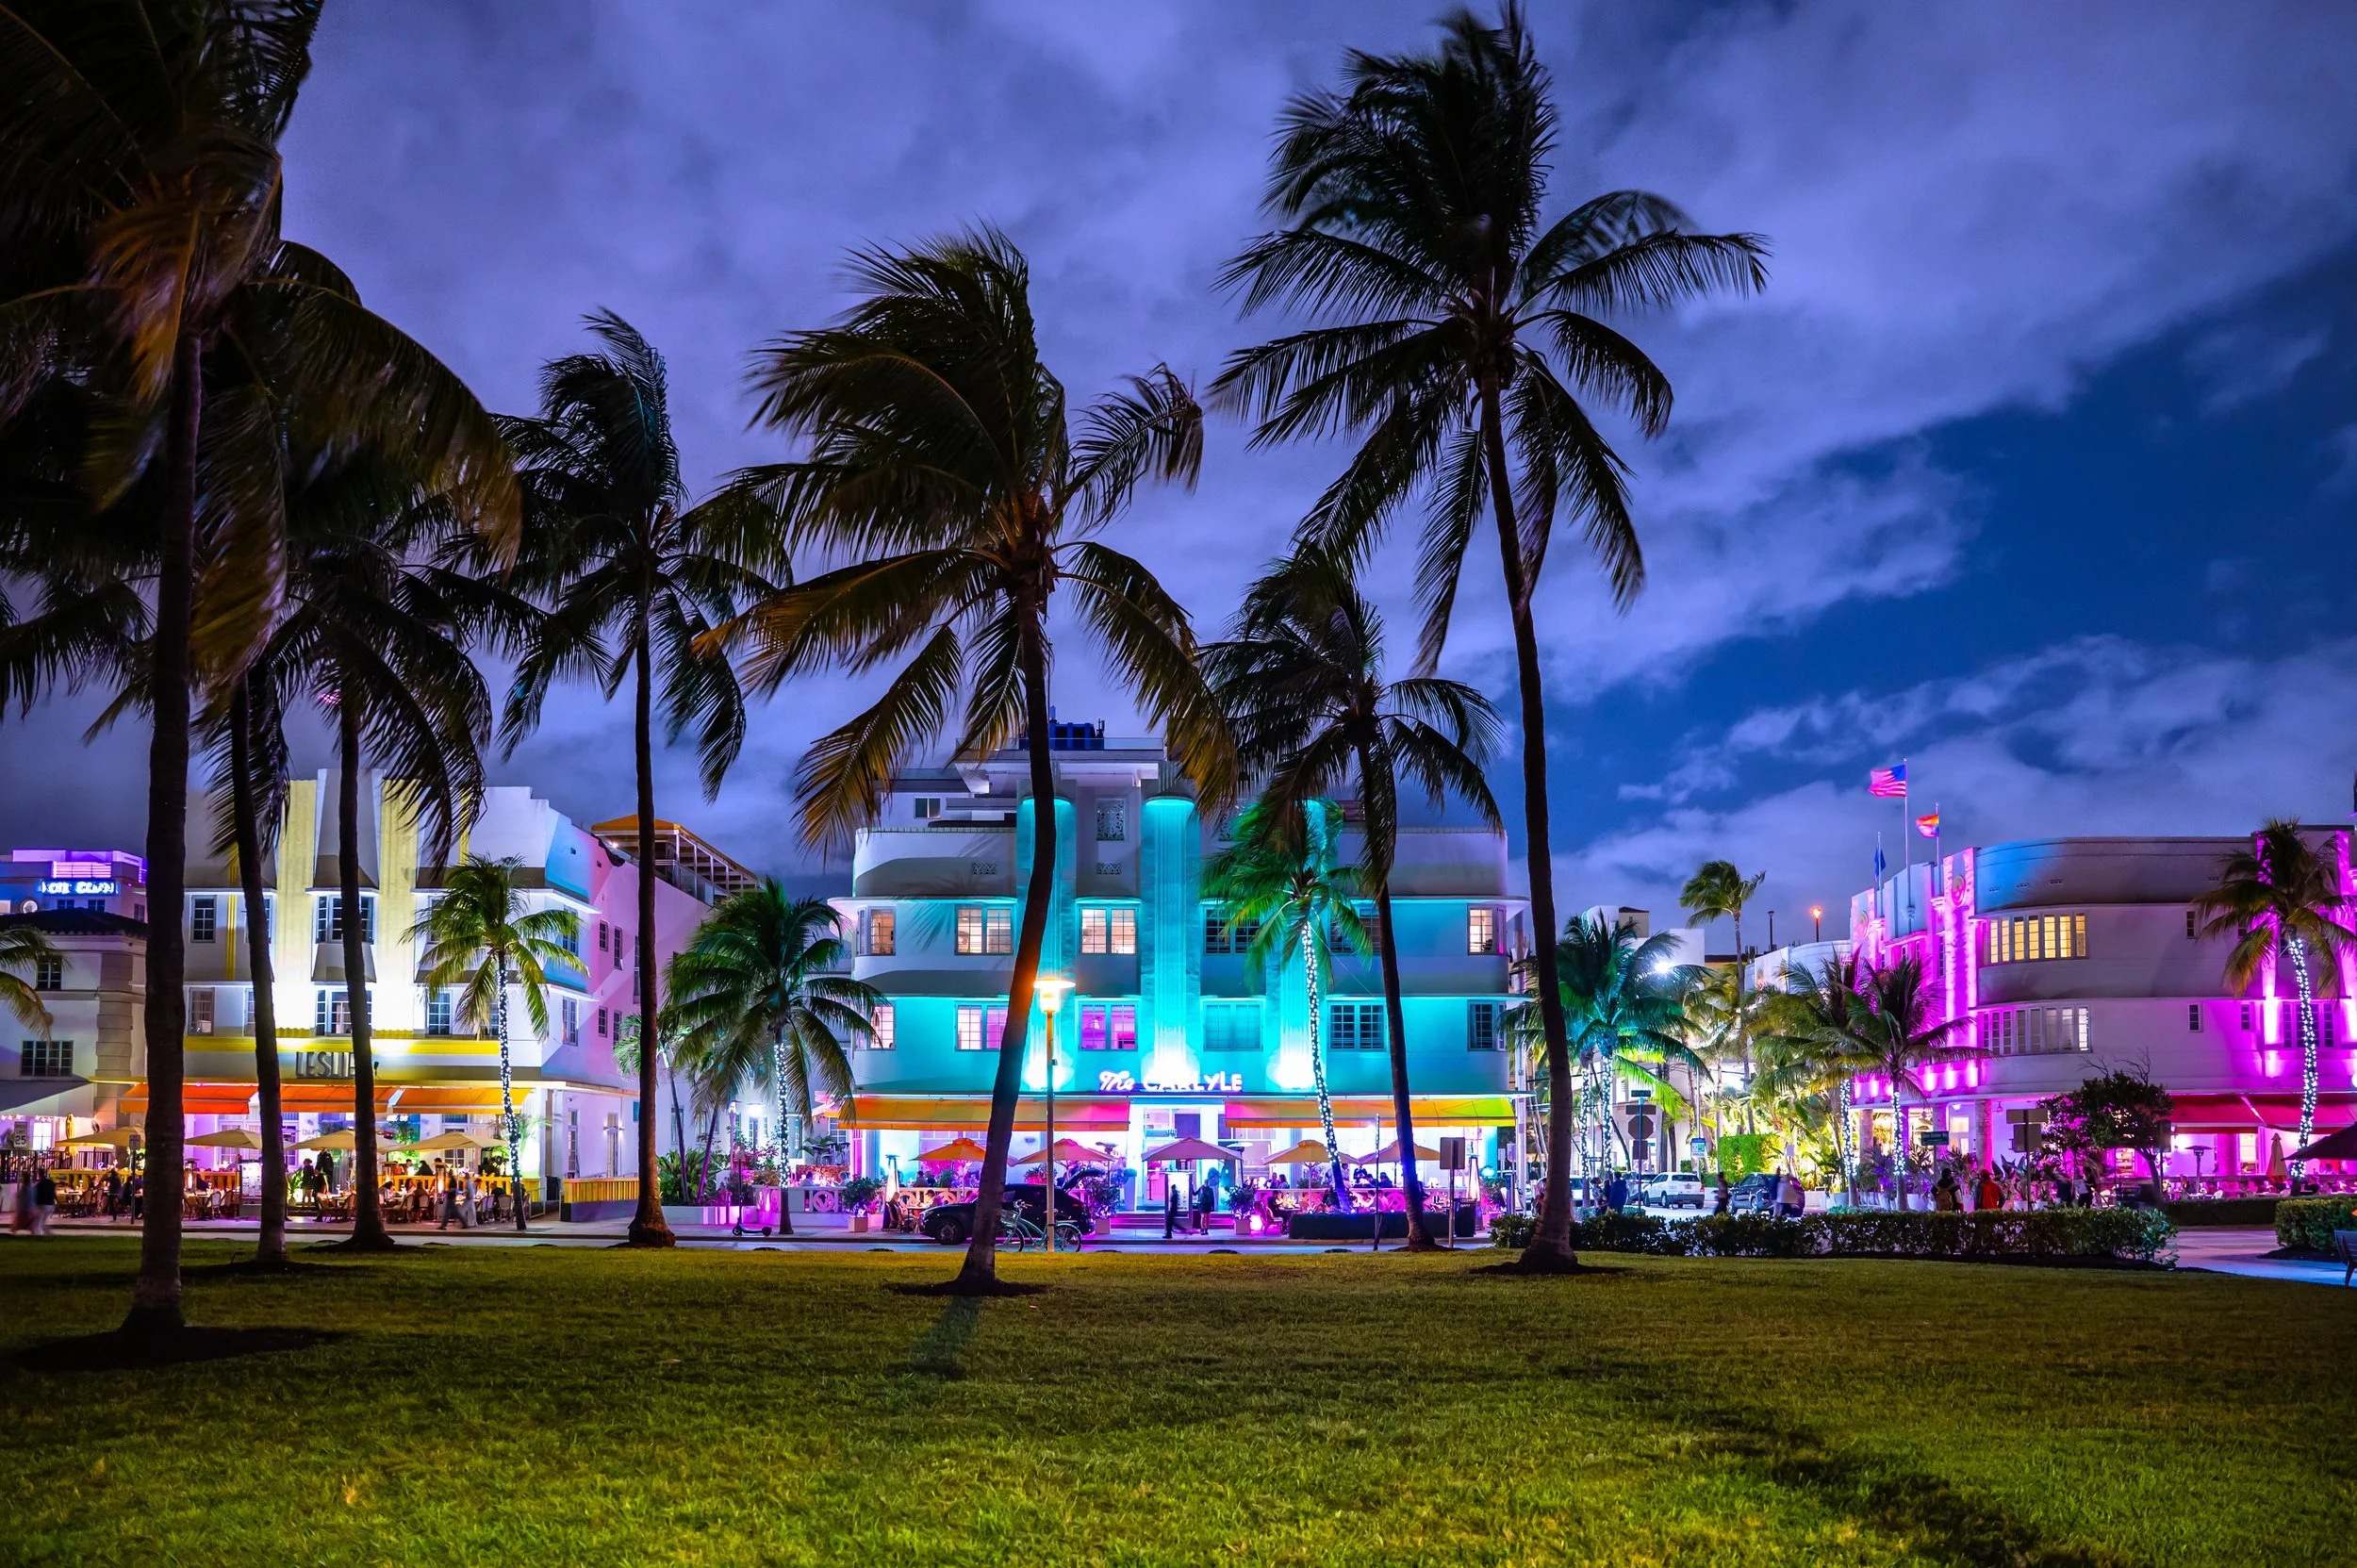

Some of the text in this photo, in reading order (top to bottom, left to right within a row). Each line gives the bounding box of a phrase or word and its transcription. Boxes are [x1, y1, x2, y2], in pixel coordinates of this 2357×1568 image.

[296, 1051, 355, 1079] LESLIE
[1099, 1070, 1135, 1091] The
[15, 1135, 26, 1145] 25
